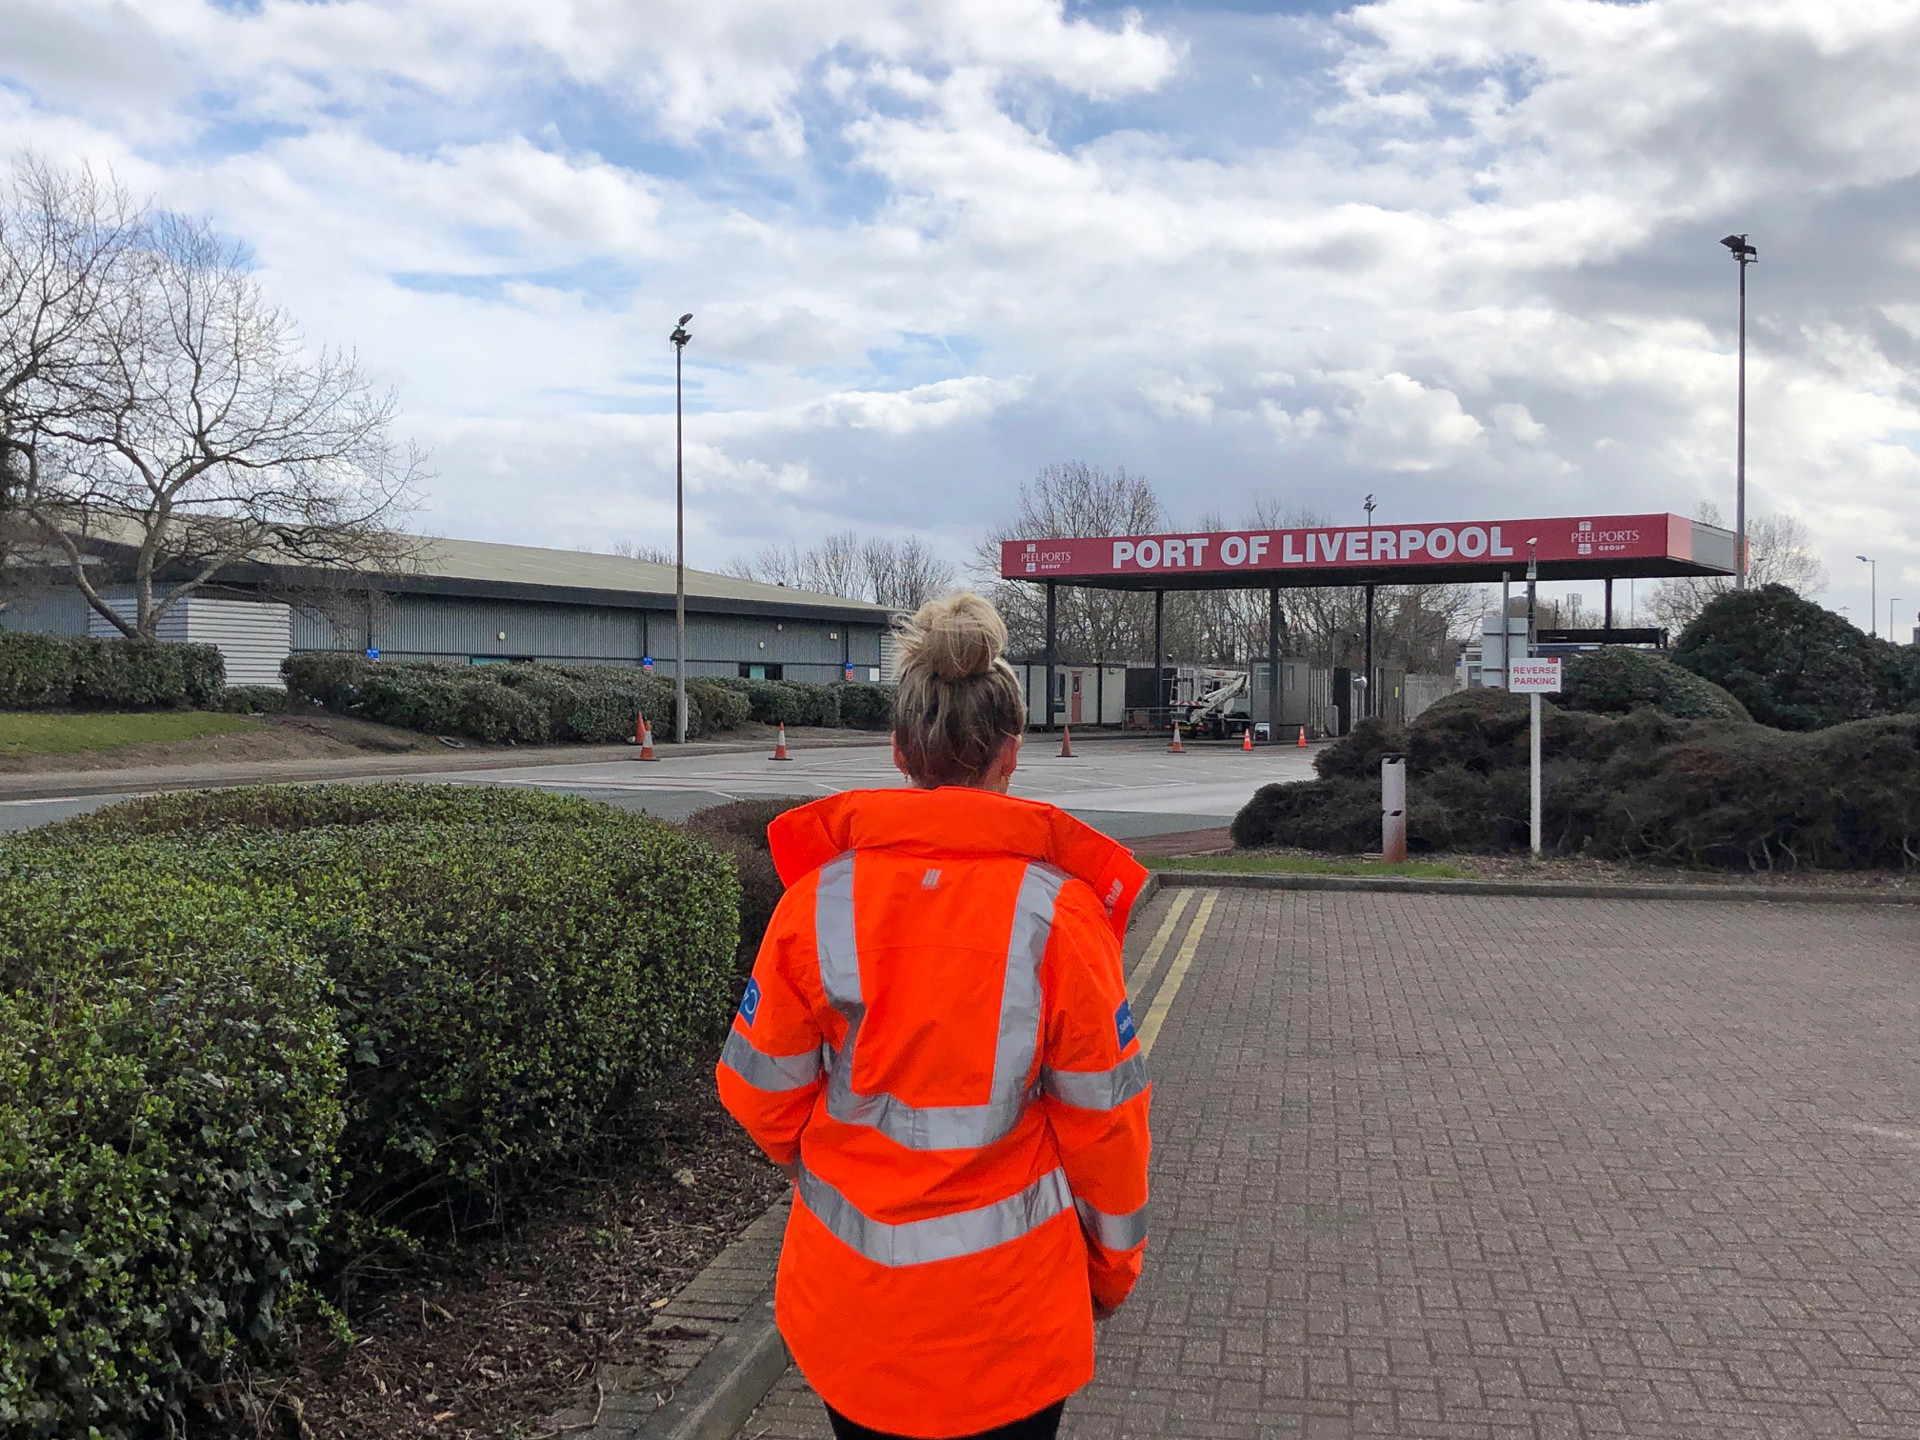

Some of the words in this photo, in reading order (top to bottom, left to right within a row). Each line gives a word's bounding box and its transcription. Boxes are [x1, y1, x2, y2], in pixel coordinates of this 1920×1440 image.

[1571, 532, 1598, 543] PEEL
[1599, 530, 1639, 542] PORTS
[1113, 538, 1209, 569] PORT
[1220, 536, 1270, 566] OF
[1282, 526, 1514, 563] LIVERPOOL
[1021, 553, 1040, 562] PEEL
[1041, 551, 1071, 562] PORTS
